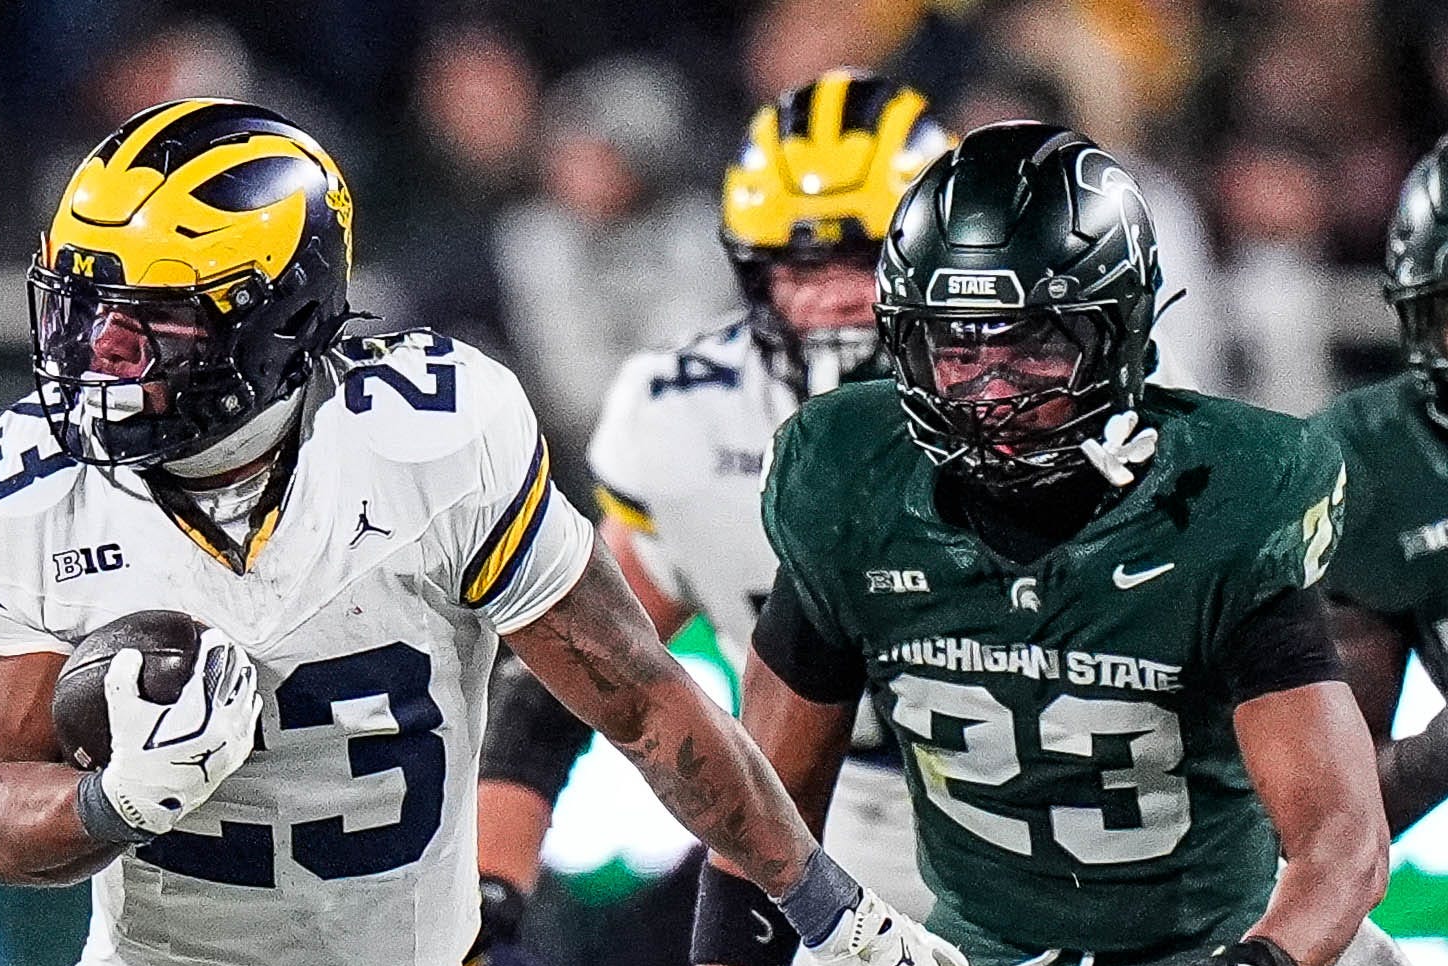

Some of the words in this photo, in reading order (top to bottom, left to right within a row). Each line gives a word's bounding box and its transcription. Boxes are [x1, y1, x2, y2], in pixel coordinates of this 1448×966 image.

[72, 252, 95, 277] M
[948, 276, 997, 295] STATE
[1303, 461, 1348, 590] 2
[1067, 651, 1184, 693] STATE
[888, 672, 1192, 865] 23
